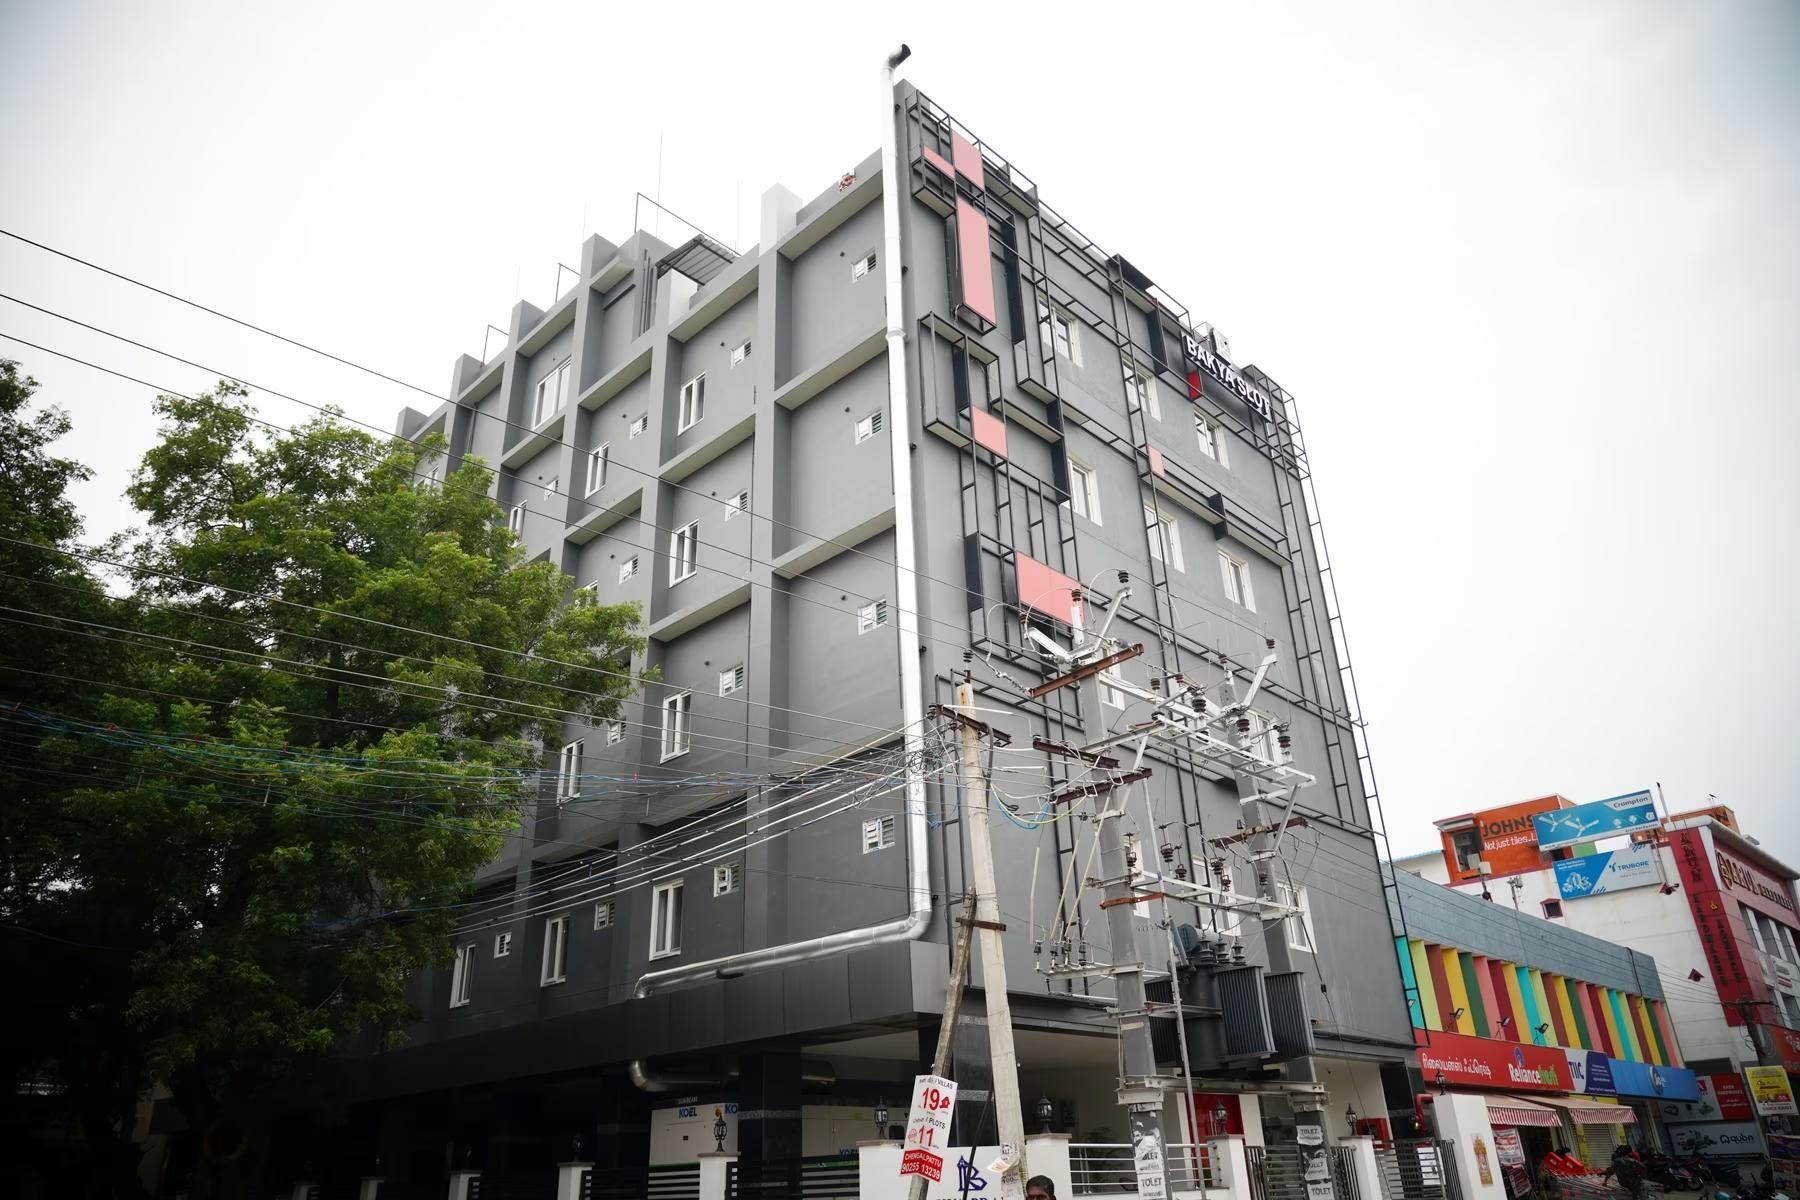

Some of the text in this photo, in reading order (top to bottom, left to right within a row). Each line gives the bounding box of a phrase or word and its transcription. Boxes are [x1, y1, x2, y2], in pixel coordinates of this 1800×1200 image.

[1184, 335, 1236, 388] BAKYA
[1484, 840, 1495, 851] Not
[1495, 838, 1510, 850] just
[922, 1087, 940, 1111] 19
[679, 1107, 698, 1119] KOEL
[928, 1117, 946, 1130] PLOTS
[919, 1125, 934, 1147] 11
